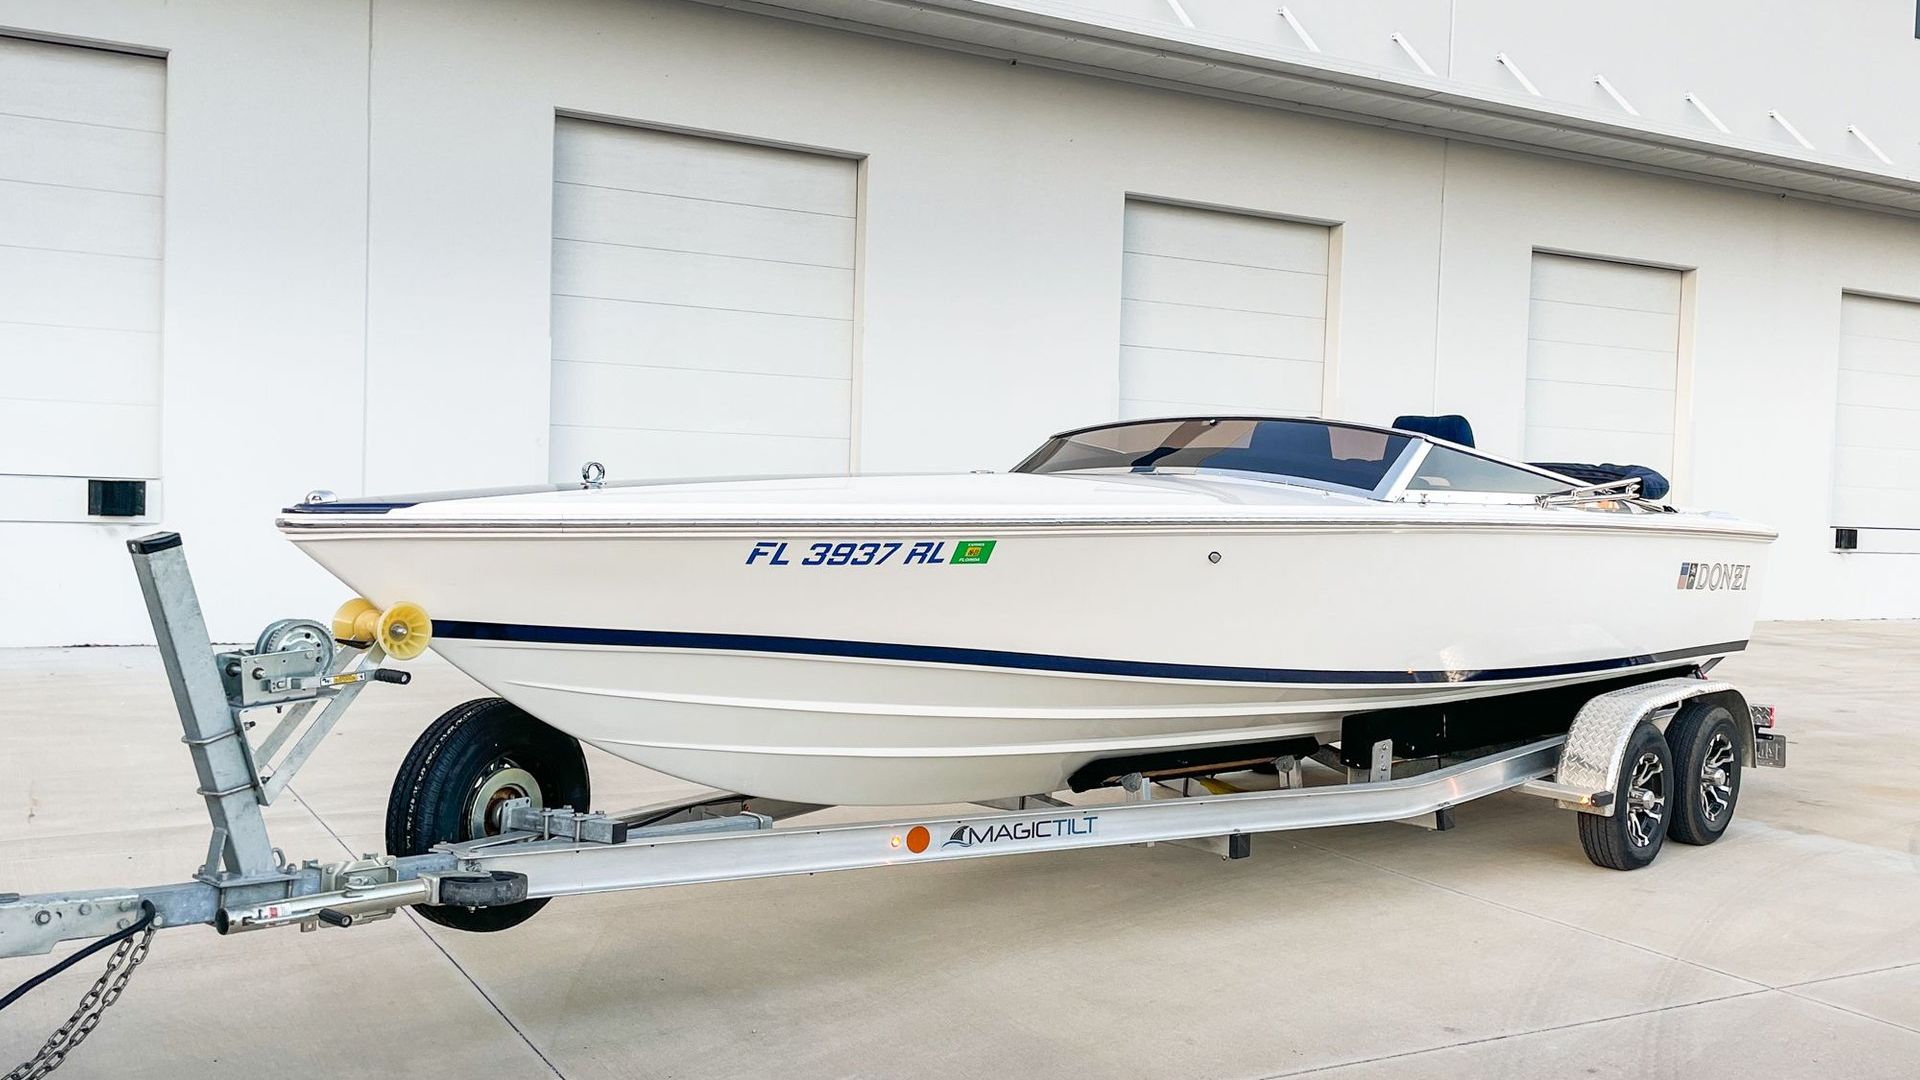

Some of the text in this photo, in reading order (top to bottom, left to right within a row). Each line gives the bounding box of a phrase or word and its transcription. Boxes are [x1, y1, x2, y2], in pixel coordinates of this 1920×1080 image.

[746, 541, 945, 565] FL 3937 RL
[1695, 562, 1750, 591] DONZI
[969, 816, 1098, 844] MAGICTILT
